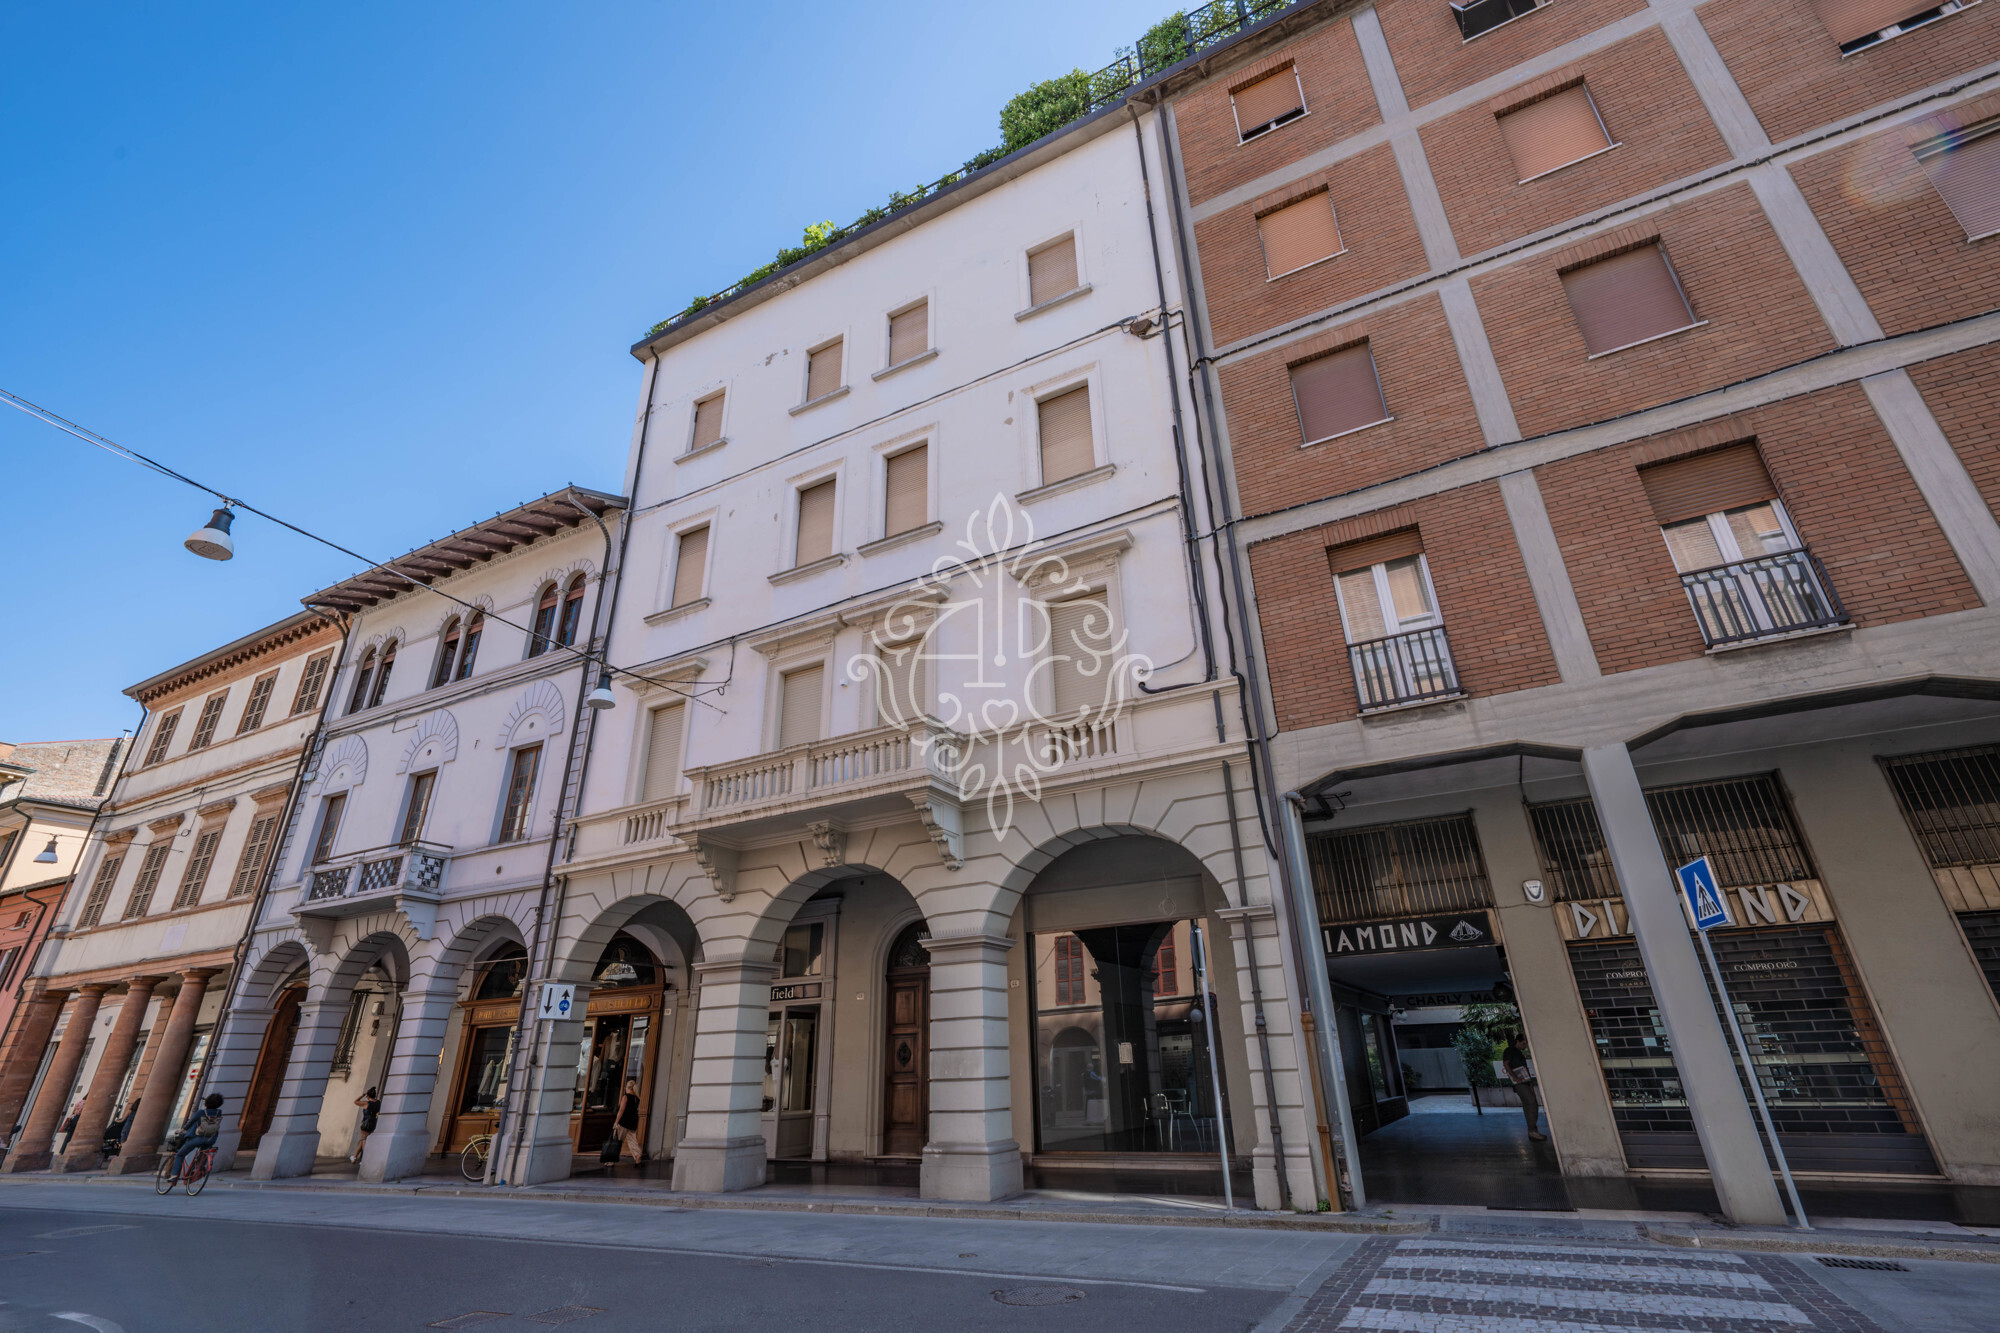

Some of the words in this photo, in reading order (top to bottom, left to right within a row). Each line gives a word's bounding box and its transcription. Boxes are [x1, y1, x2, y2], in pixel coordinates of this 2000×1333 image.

[1570, 884, 1810, 938] DIND
[1324, 921, 1438, 953] IAMOND
[1733, 962, 1774, 972] COMPRO
[1775, 960, 1798, 969] ORO
[1606, 970, 1643, 979] COMPRO
[771, 986, 795, 1000] field
[1407, 993, 1462, 1006] CHARLY
[1470, 992, 1498, 1004] MA
